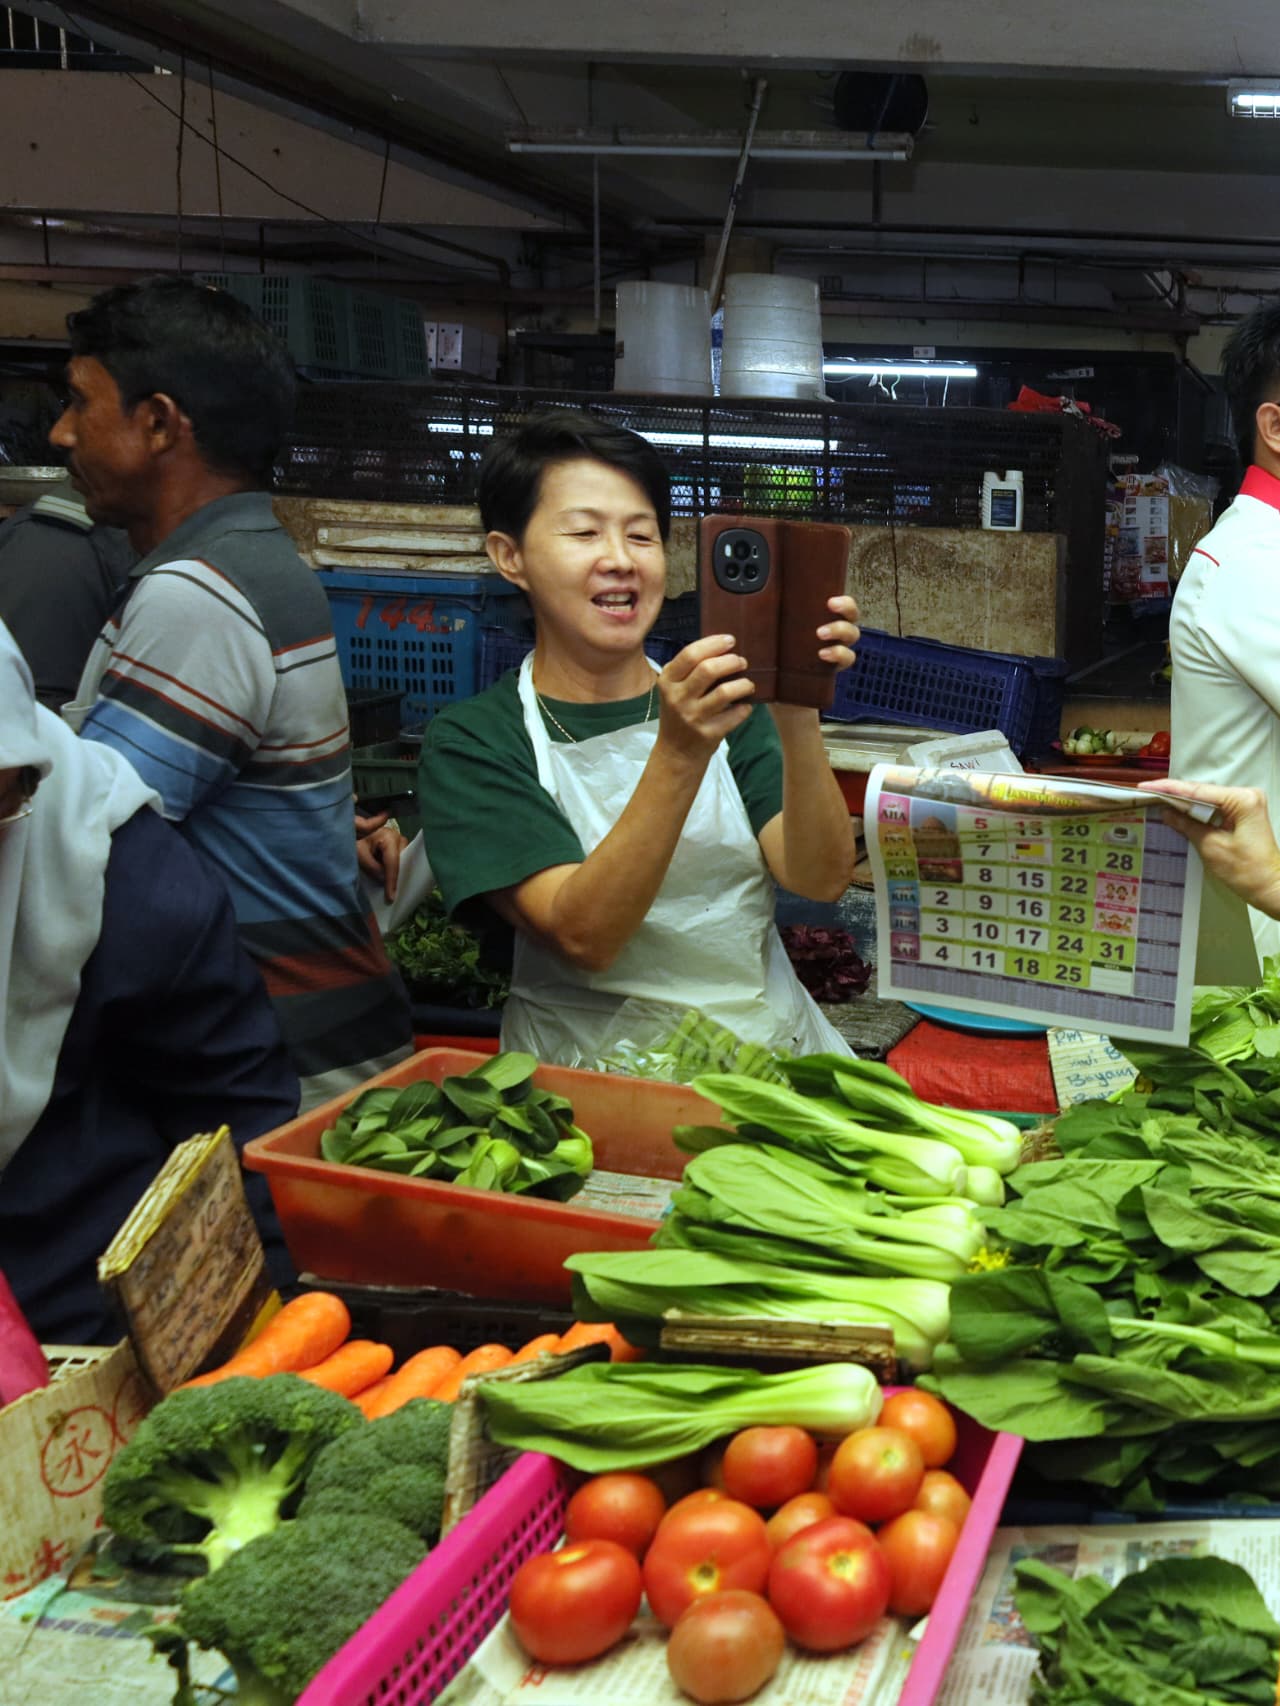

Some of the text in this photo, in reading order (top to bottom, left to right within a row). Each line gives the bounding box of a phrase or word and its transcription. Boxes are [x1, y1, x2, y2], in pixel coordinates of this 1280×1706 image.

[355, 596, 437, 632] 144
[974, 818, 988, 829] 5
[1061, 825, 1090, 837] 20
[977, 845, 991, 857] 7
[1061, 847, 1088, 865] 21
[1105, 852, 1133, 871] 28
[979, 868, 992, 882] 8
[1017, 871, 1044, 888] 15
[1061, 876, 1088, 894] 22
[936, 891, 949, 906] 2
[979, 895, 992, 910] 9
[1016, 899, 1043, 917] 16
[1058, 905, 1086, 924] 23
[936, 918, 949, 933] 3
[973, 922, 999, 939] 10
[1016, 928, 1041, 946] 17
[1057, 935, 1083, 953] 24
[1100, 942, 1124, 961] 31
[935, 945, 948, 961] 4
[972, 950, 995, 968] 11
[1014, 957, 1039, 975] 18
[1055, 964, 1082, 982] 25
[55, 1424, 102, 1485] 永
